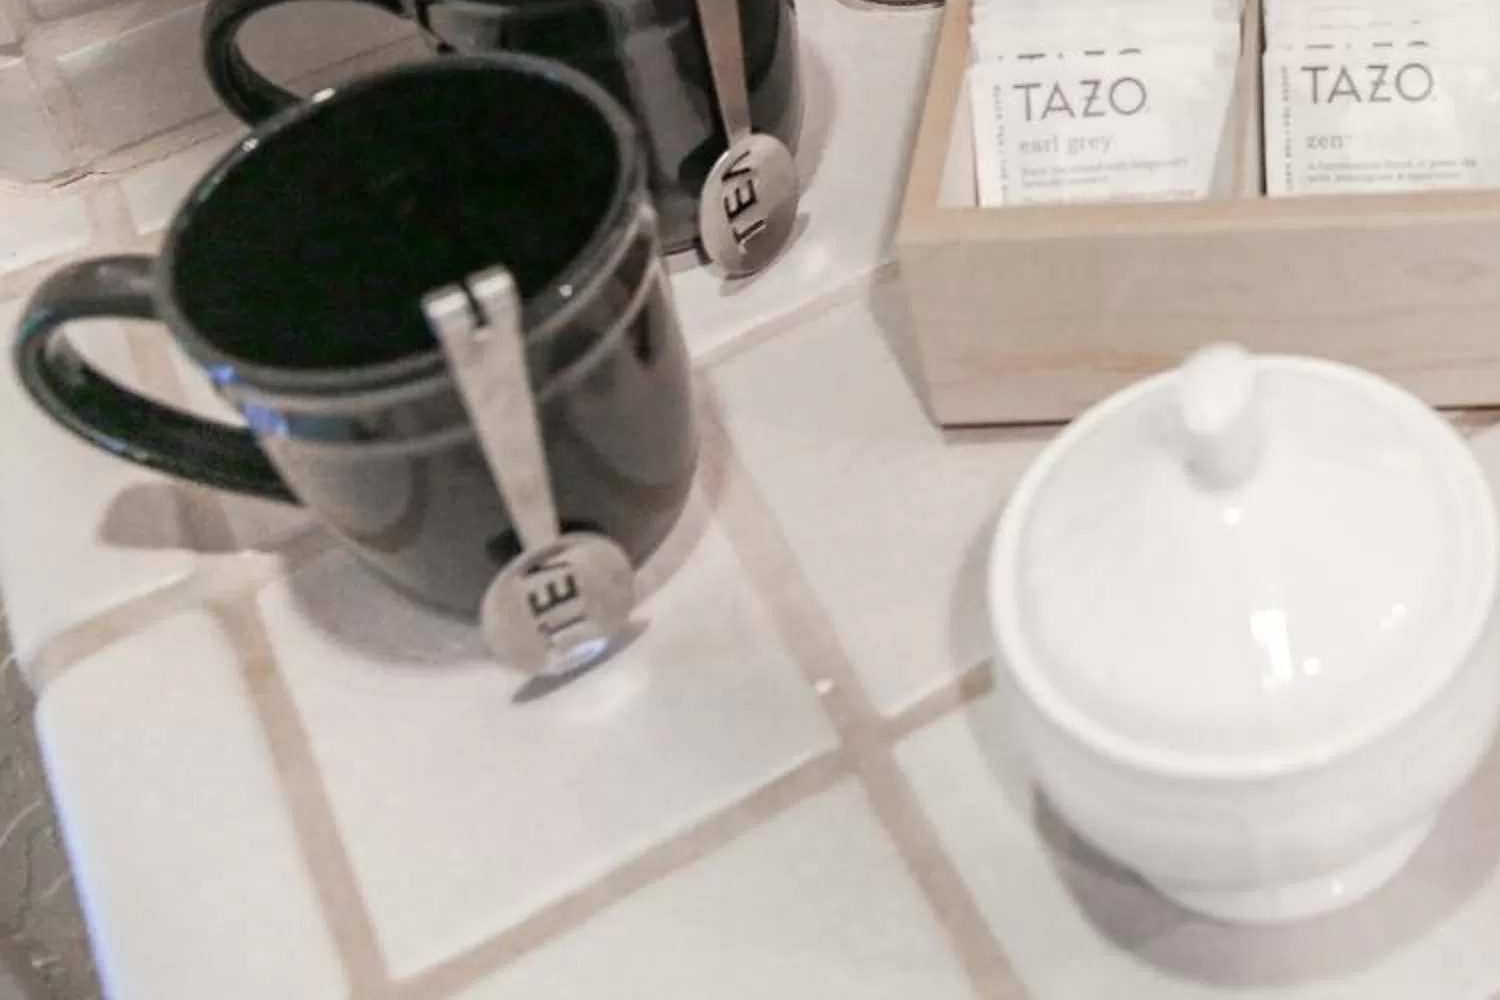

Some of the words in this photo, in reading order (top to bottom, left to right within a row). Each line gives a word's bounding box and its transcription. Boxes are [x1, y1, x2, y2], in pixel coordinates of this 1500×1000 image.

[1012, 76, 1147, 121] TAZO
[1300, 62, 1434, 104] TAZO
[1019, 134, 1059, 153] earl
[1066, 134, 1114, 156] grey
[1306, 134, 1343, 150] zen
[721, 150, 768, 252] TEA
